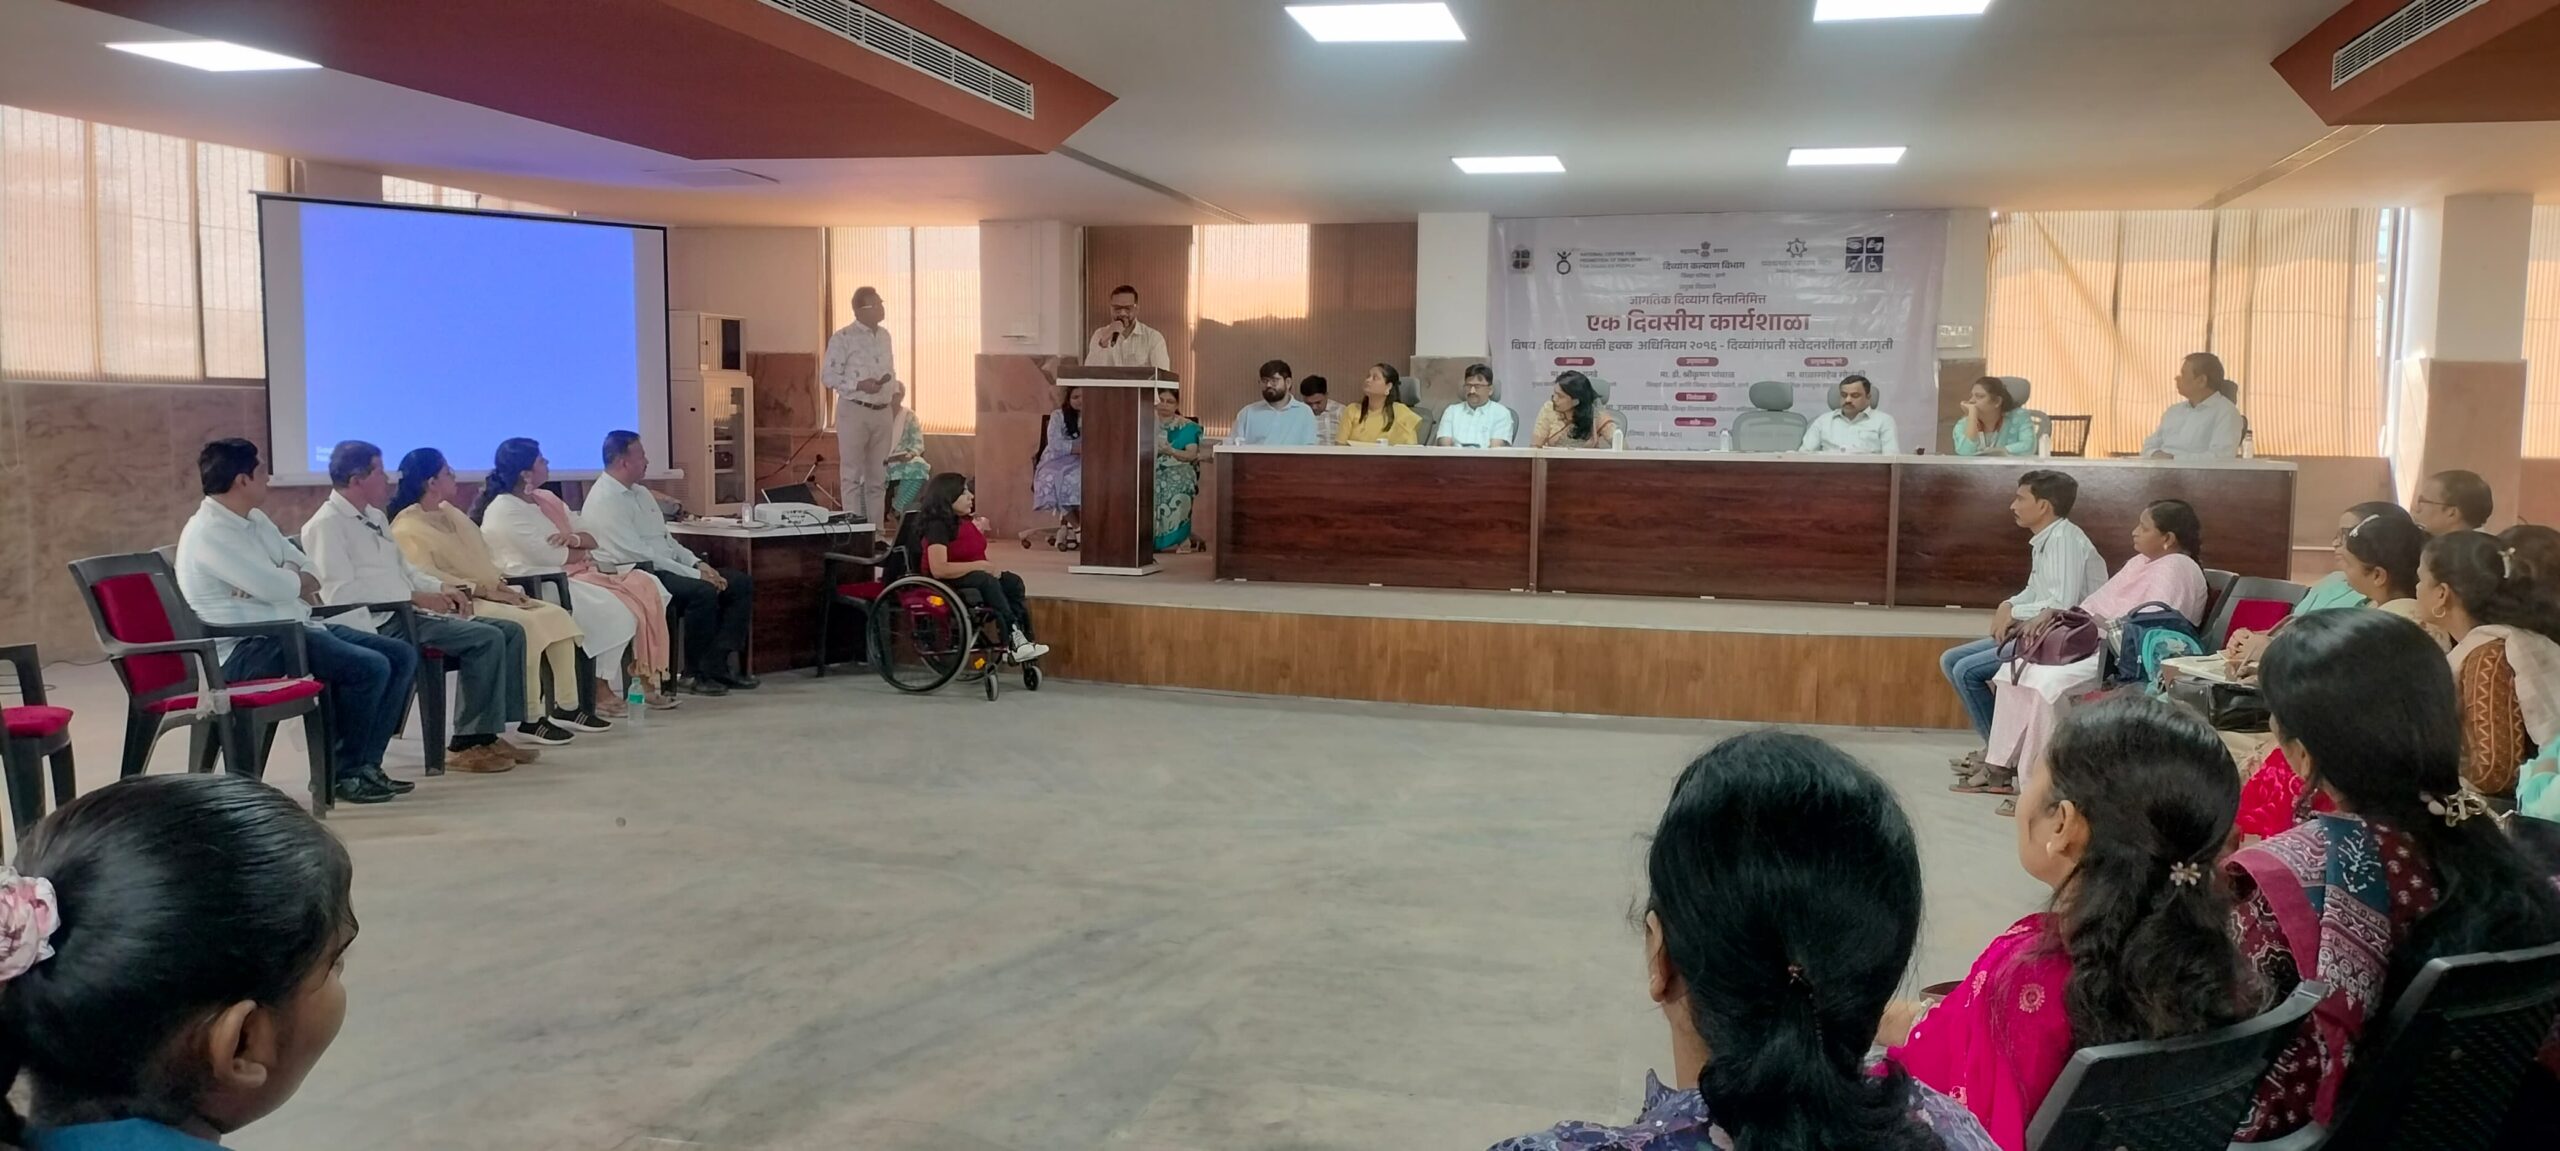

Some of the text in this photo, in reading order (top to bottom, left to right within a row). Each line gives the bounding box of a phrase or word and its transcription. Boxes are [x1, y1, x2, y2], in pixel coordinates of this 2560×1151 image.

[1690, 261, 1720, 269] कल्याण
[1721, 260, 1745, 269] विभाग
[1629, 293, 1672, 305] जागतिक
[1712, 292, 1767, 305] दिनानिमित्त
[1586, 307, 1812, 333] एक दिवसीय कार्यशाळा
[1511, 338, 1537, 351] विषय
[1543, 338, 1577, 351] दिव्यांग
[1608, 341, 1633, 352] हक्क
[1637, 338, 1687, 350] अधिनियम
[1689, 341, 1717, 351] २०१६
[1727, 338, 1787, 351] दिव्यांगांप्रती
[1859, 337, 1894, 353] जागृती
